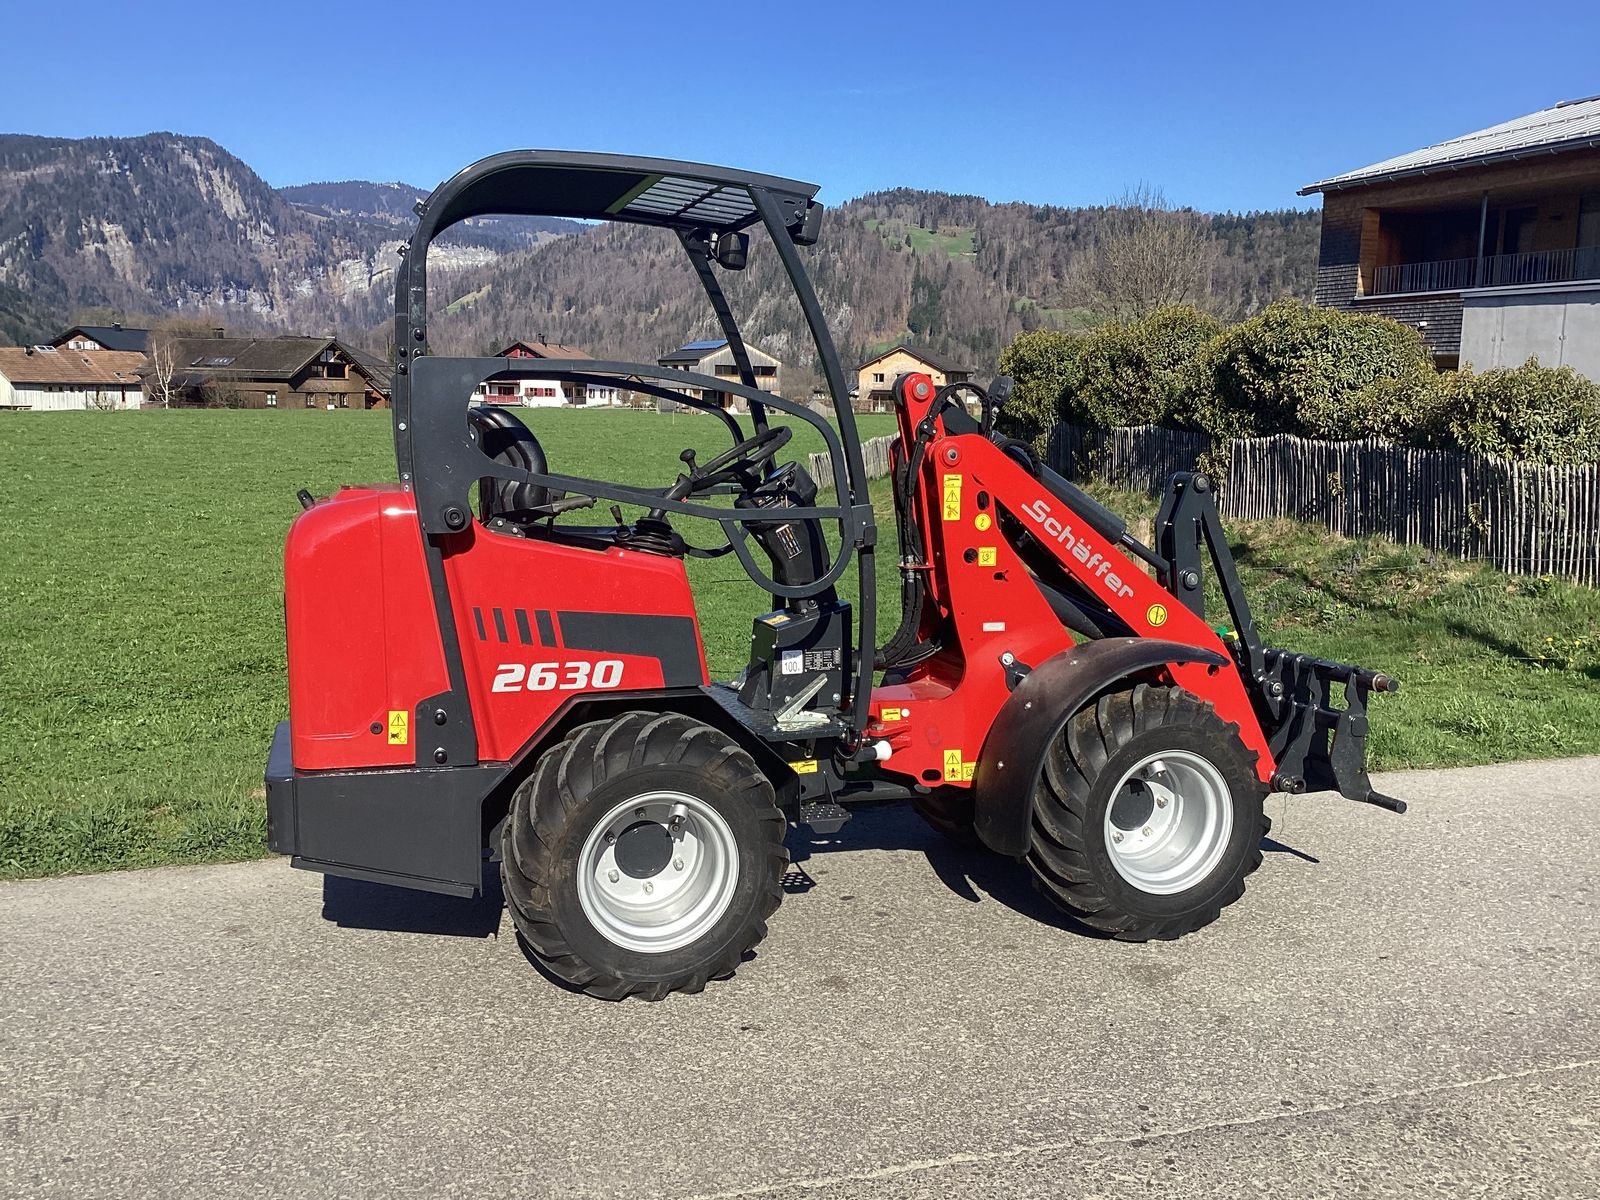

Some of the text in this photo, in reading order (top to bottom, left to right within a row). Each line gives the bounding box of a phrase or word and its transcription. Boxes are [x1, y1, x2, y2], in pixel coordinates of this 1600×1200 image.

[1021, 500, 1134, 598] Schäffer
[491, 660, 625, 693] 2630
[784, 661, 797, 672] 100
